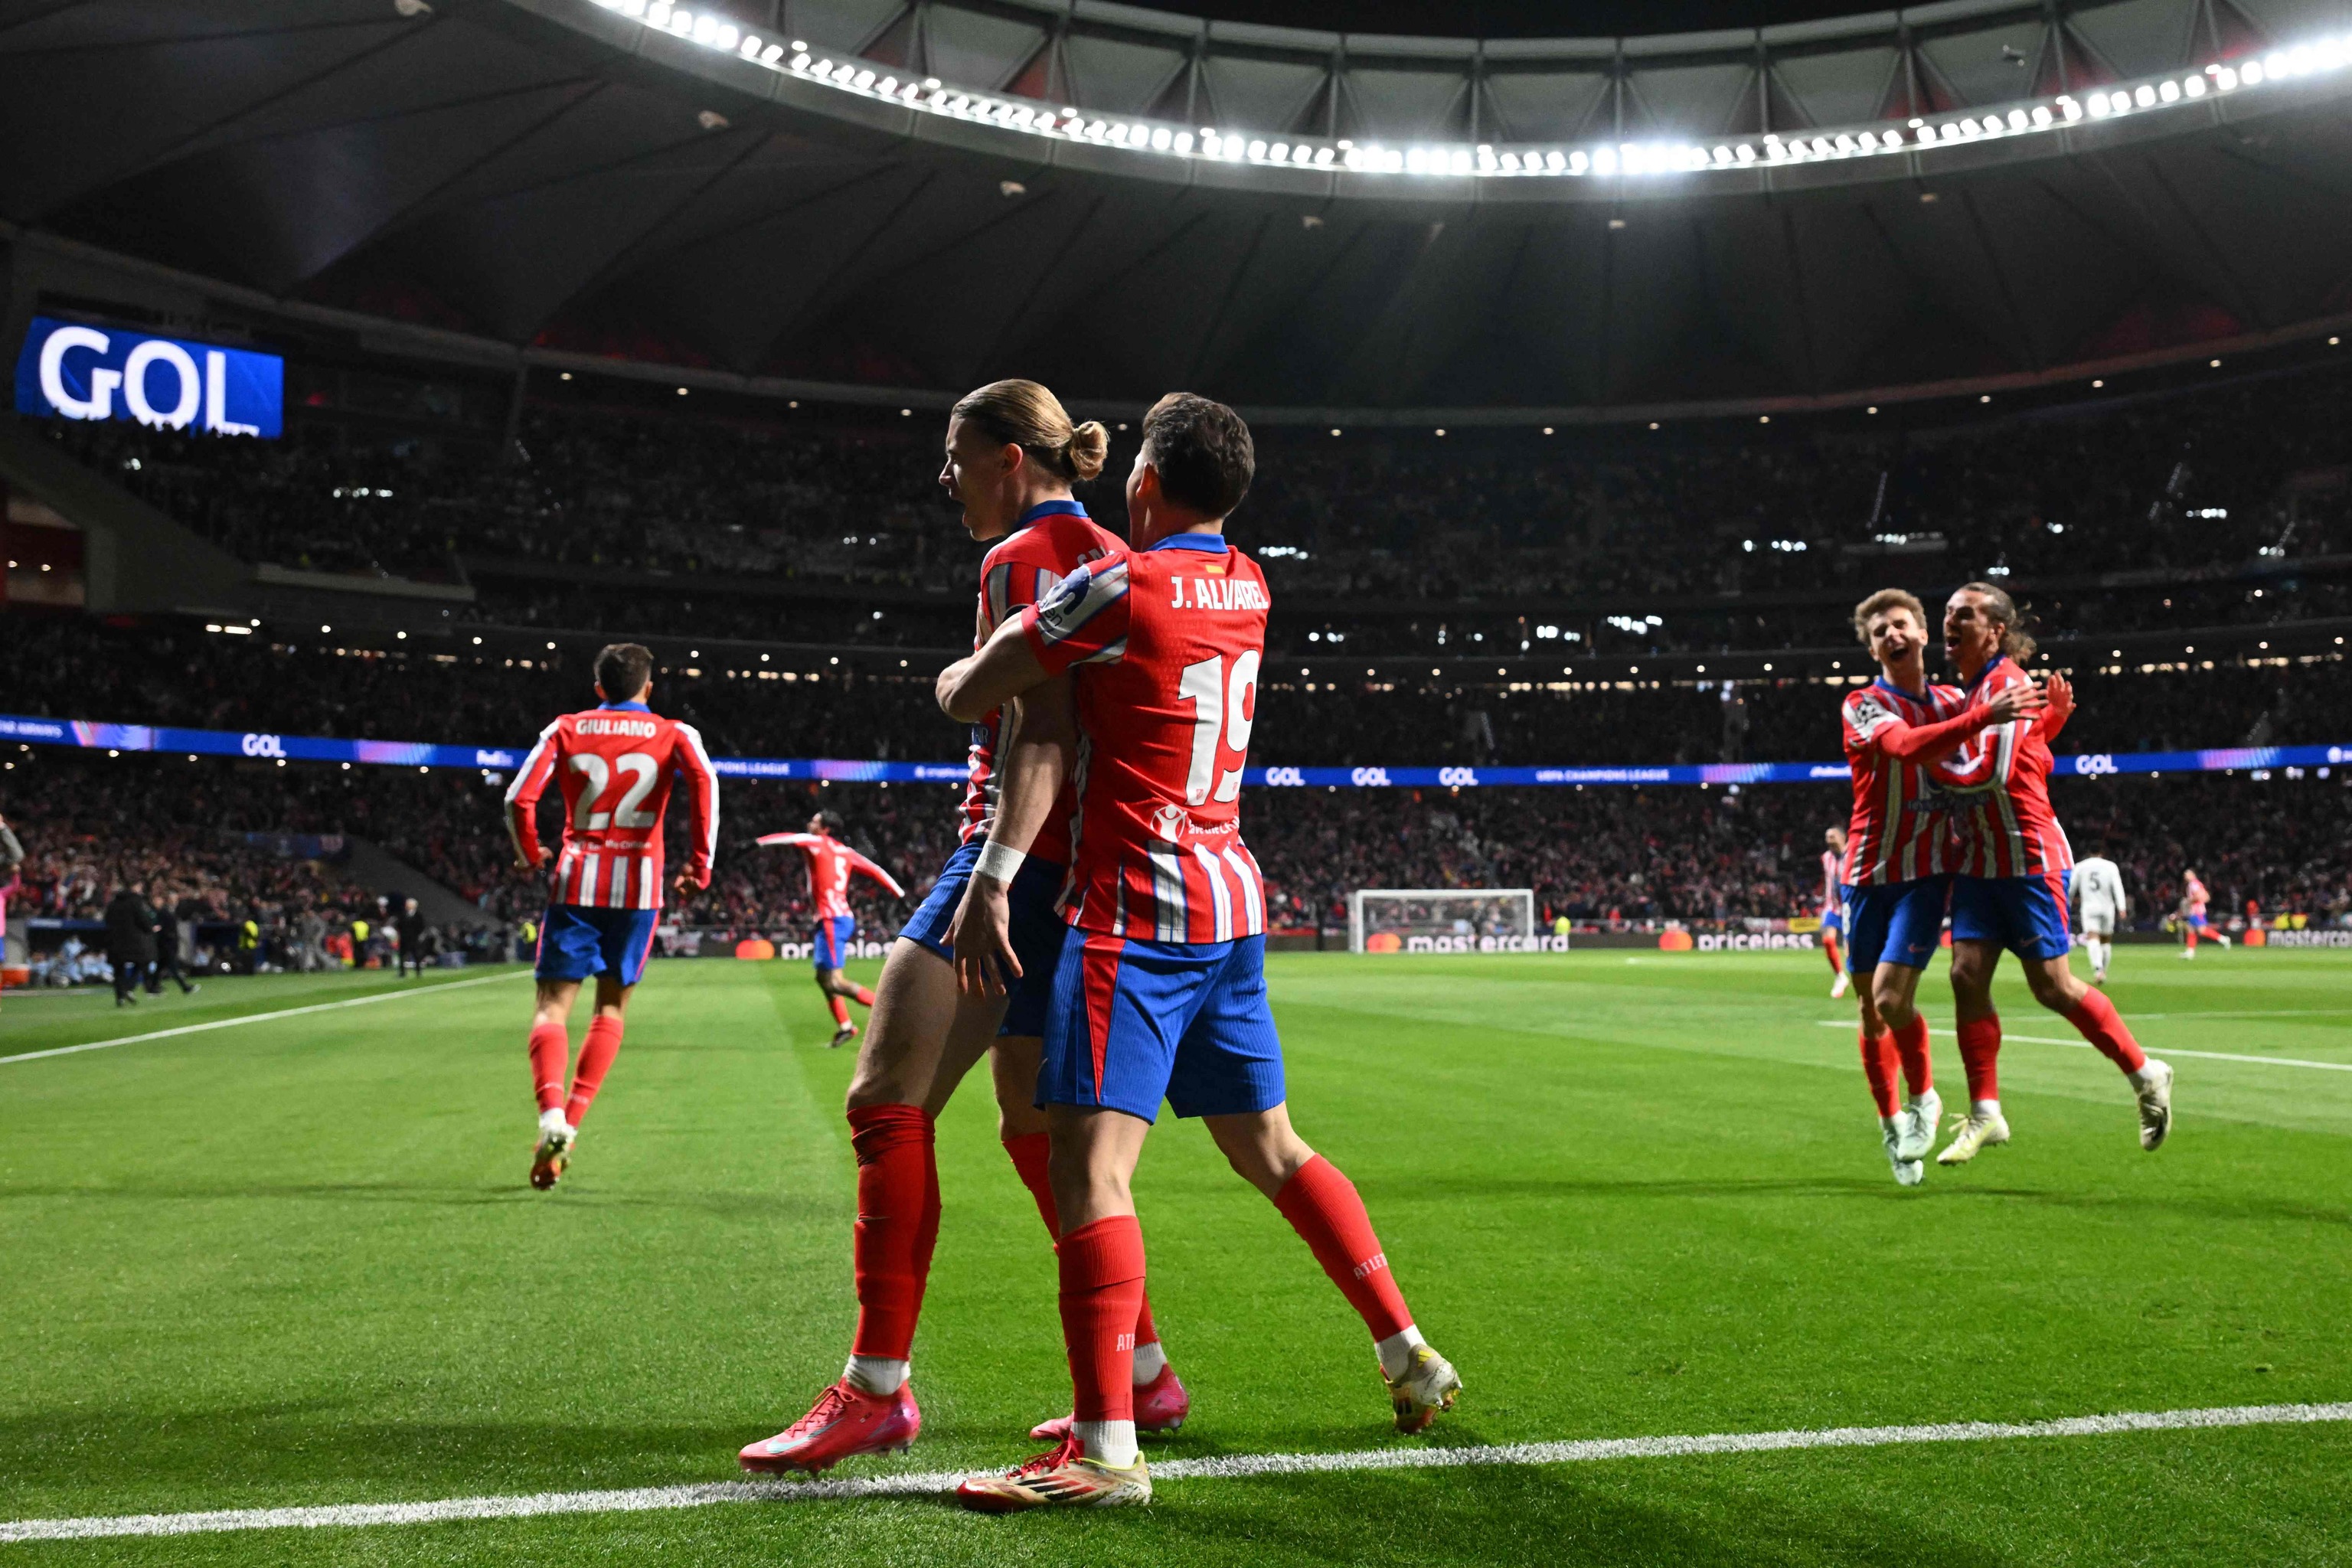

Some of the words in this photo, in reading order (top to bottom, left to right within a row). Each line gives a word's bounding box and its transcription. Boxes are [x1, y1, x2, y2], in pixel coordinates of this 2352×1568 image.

[40, 326, 260, 438] GOL
[1171, 576, 1192, 609] J.
[1178, 649, 1260, 806] 19
[242, 733, 287, 758] GOL
[1266, 766, 1305, 786] GOL
[1351, 766, 1392, 786] GOL
[1439, 766, 1479, 786] GOL
[2075, 754, 2118, 775] GOL
[568, 753, 658, 831] 22
[2089, 871, 2101, 893] 5
[1697, 929, 1814, 952] priceless
